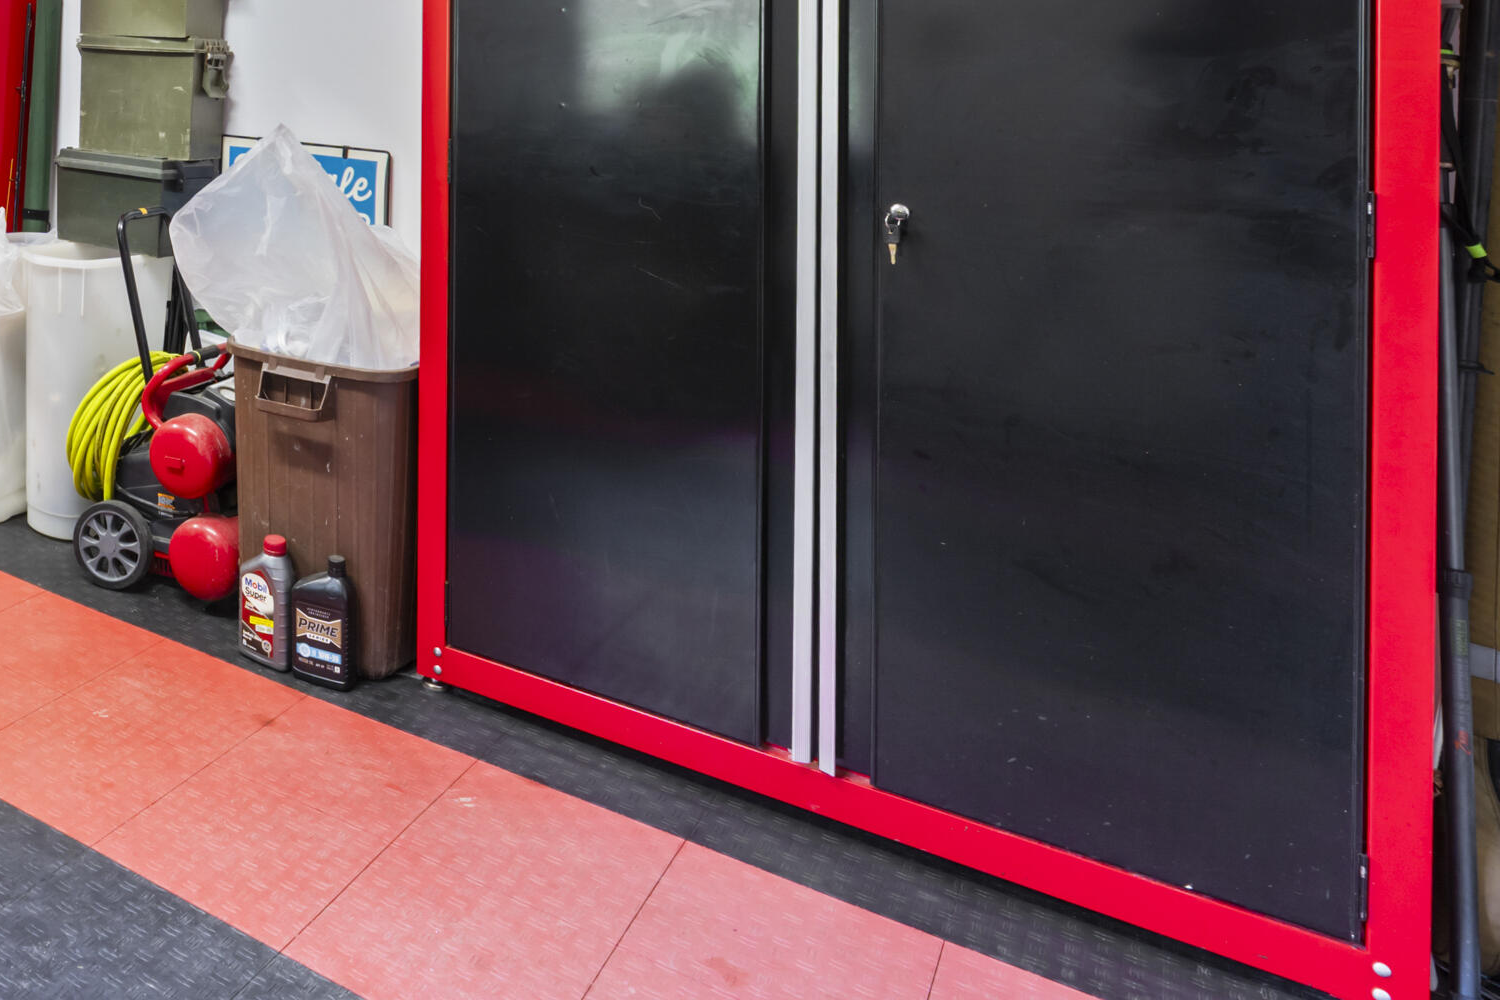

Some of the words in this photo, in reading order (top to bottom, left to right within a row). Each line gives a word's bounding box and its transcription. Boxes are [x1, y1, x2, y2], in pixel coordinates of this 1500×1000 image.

[244, 576, 268, 594] Mobil
[244, 586, 267, 602] Super
[298, 617, 339, 638] PRIME
